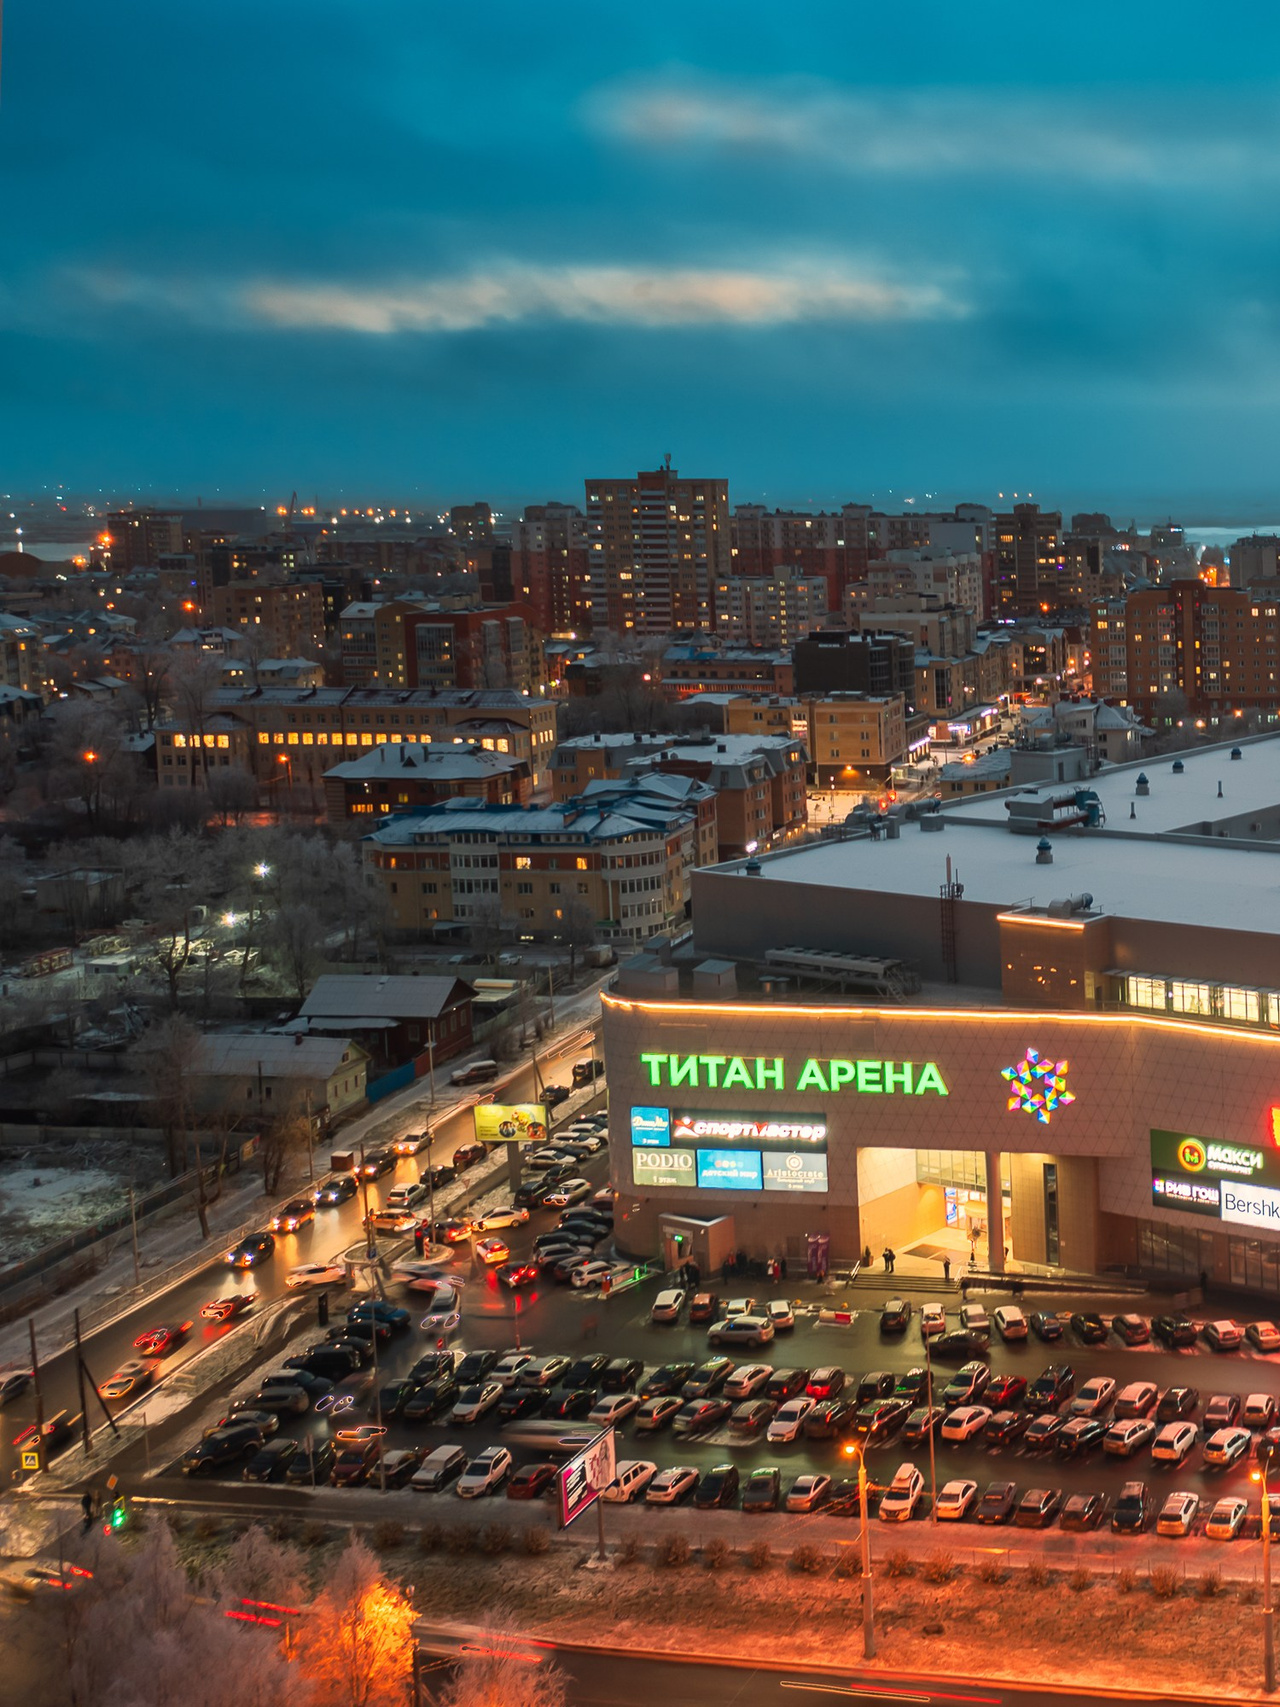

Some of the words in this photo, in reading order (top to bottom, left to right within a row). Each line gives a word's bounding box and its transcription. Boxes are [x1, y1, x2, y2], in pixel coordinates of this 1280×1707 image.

[641, 1053, 784, 1090] ТИТАН
[796, 1058, 949, 1096] АРЕНА
[636, 1152, 692, 1169] PODIO
